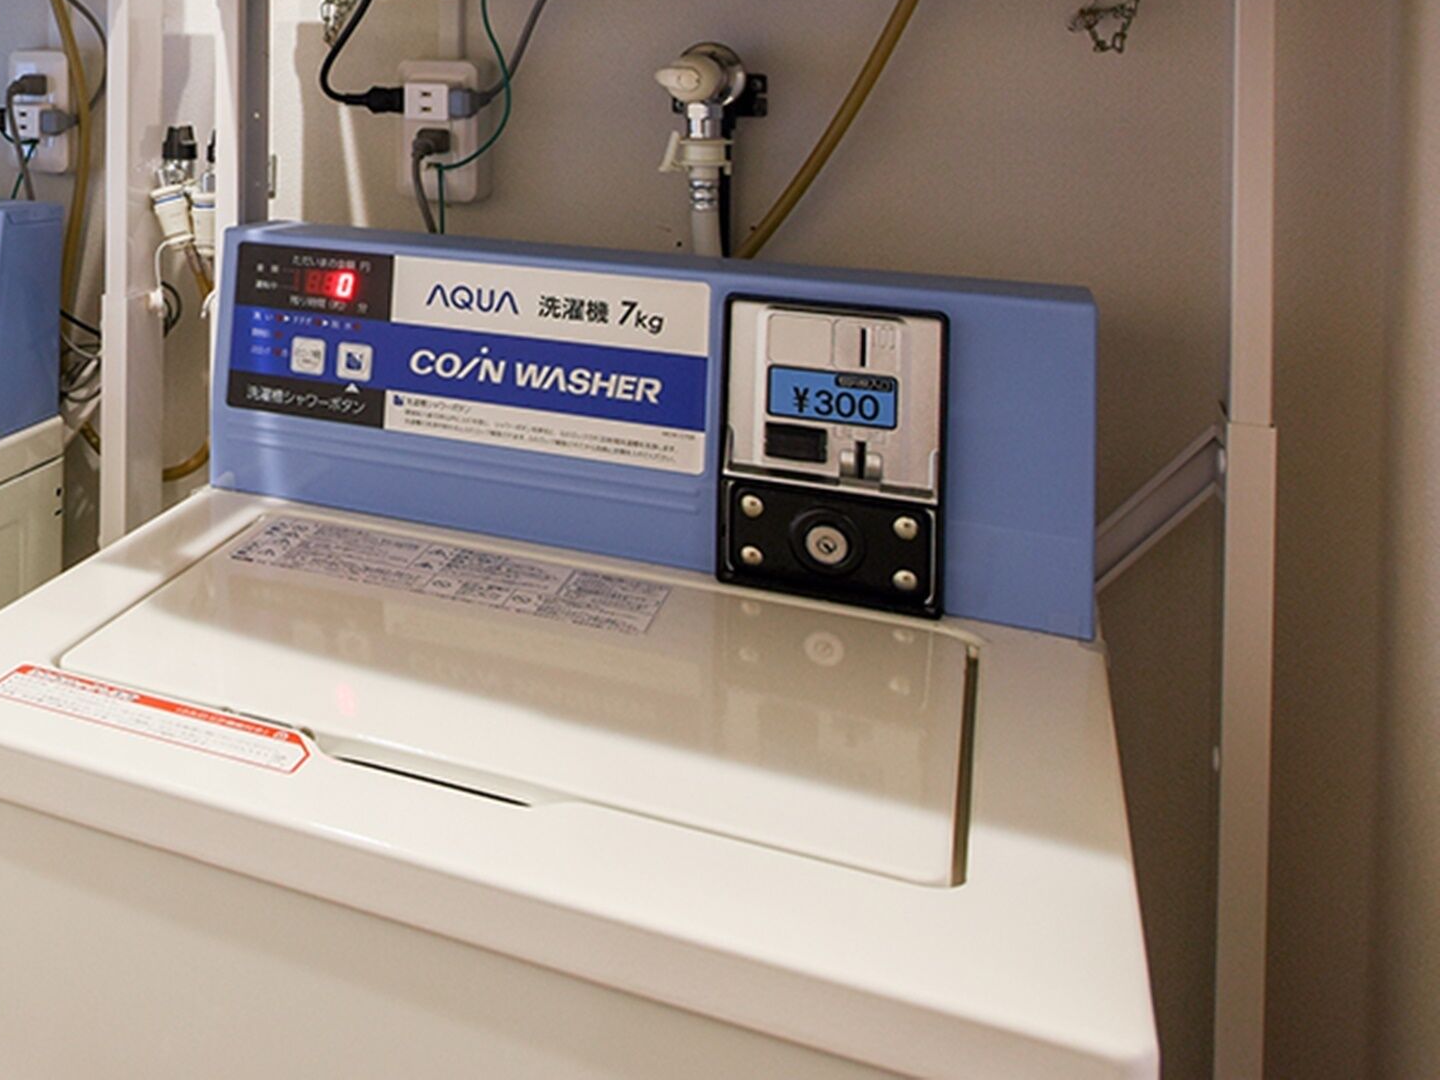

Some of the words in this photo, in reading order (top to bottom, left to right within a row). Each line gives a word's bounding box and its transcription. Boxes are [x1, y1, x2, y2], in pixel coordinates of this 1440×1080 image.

[335, 272, 356, 300] 0
[426, 283, 520, 316] AQUA
[537, 294, 610, 324] 洗濯機
[618, 300, 665, 336] 7kg
[515, 362, 664, 404] WASHER
[792, 385, 880, 422] ¥300
